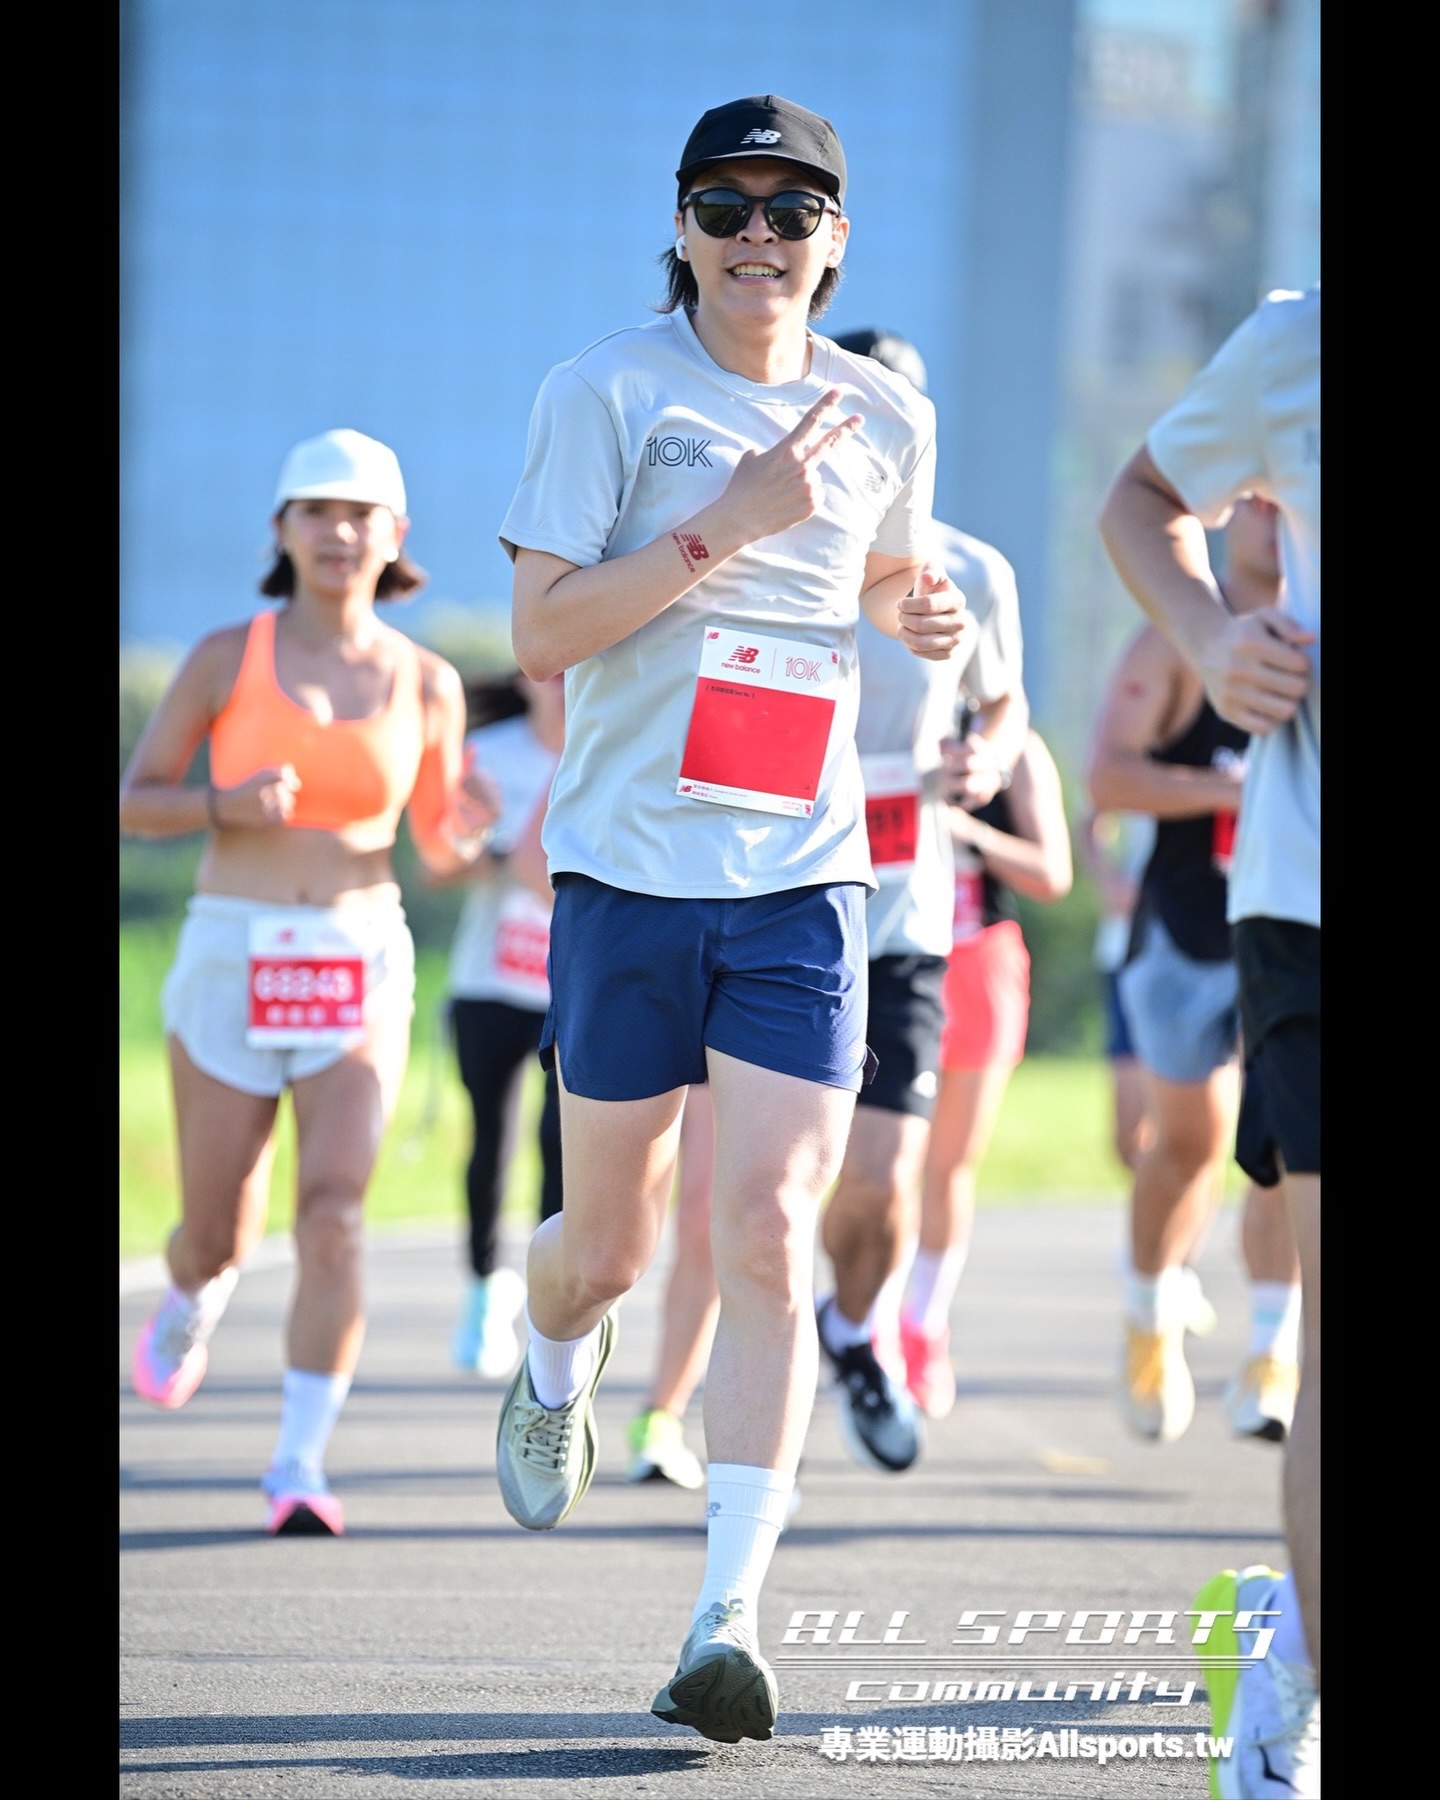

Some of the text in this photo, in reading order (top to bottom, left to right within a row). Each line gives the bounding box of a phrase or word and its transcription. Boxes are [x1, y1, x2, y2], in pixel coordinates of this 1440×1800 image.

[646, 436, 713, 468] 10K
[671, 532, 696, 573] new balance
[735, 664, 761, 674] balance
[785, 656, 823, 682] 10K
